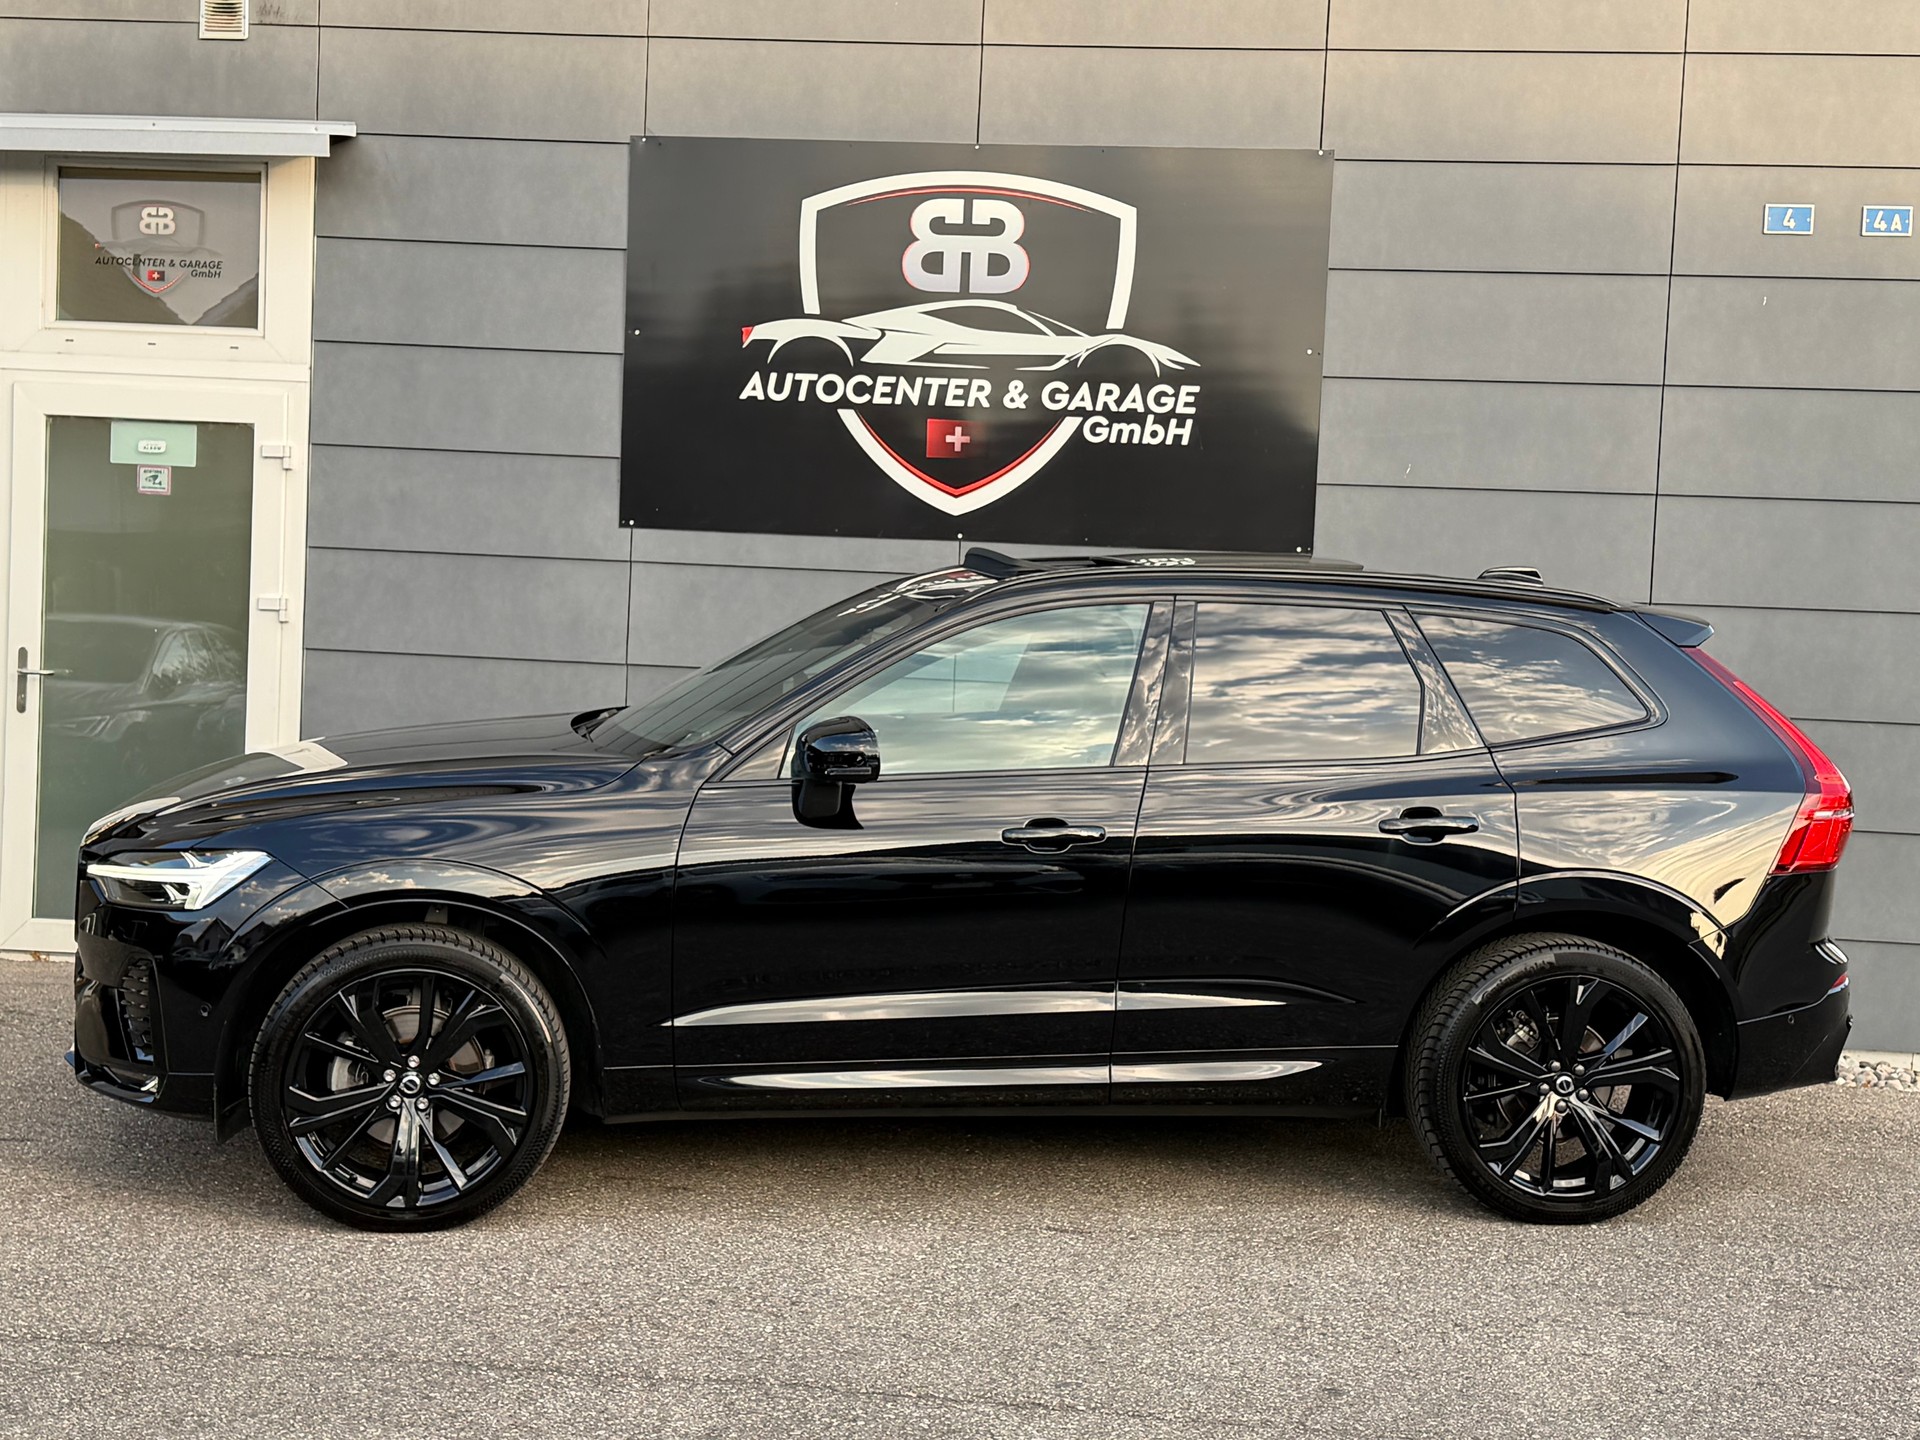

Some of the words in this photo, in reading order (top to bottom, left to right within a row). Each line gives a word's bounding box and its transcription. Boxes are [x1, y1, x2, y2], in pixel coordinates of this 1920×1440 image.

[1782, 208, 1796, 229] 4
[1873, 210, 1902, 232] 4A
[95, 256, 166, 268] AUTOCENTER
[168, 259, 176, 268] &
[179, 259, 223, 270] GARAGE
[190, 269, 221, 278] GmbH
[739, 371, 992, 408] AUTOCENTER
[1002, 379, 1029, 409] &
[1041, 380, 1201, 415] GARAGE
[1082, 413, 1194, 446] GmbH
